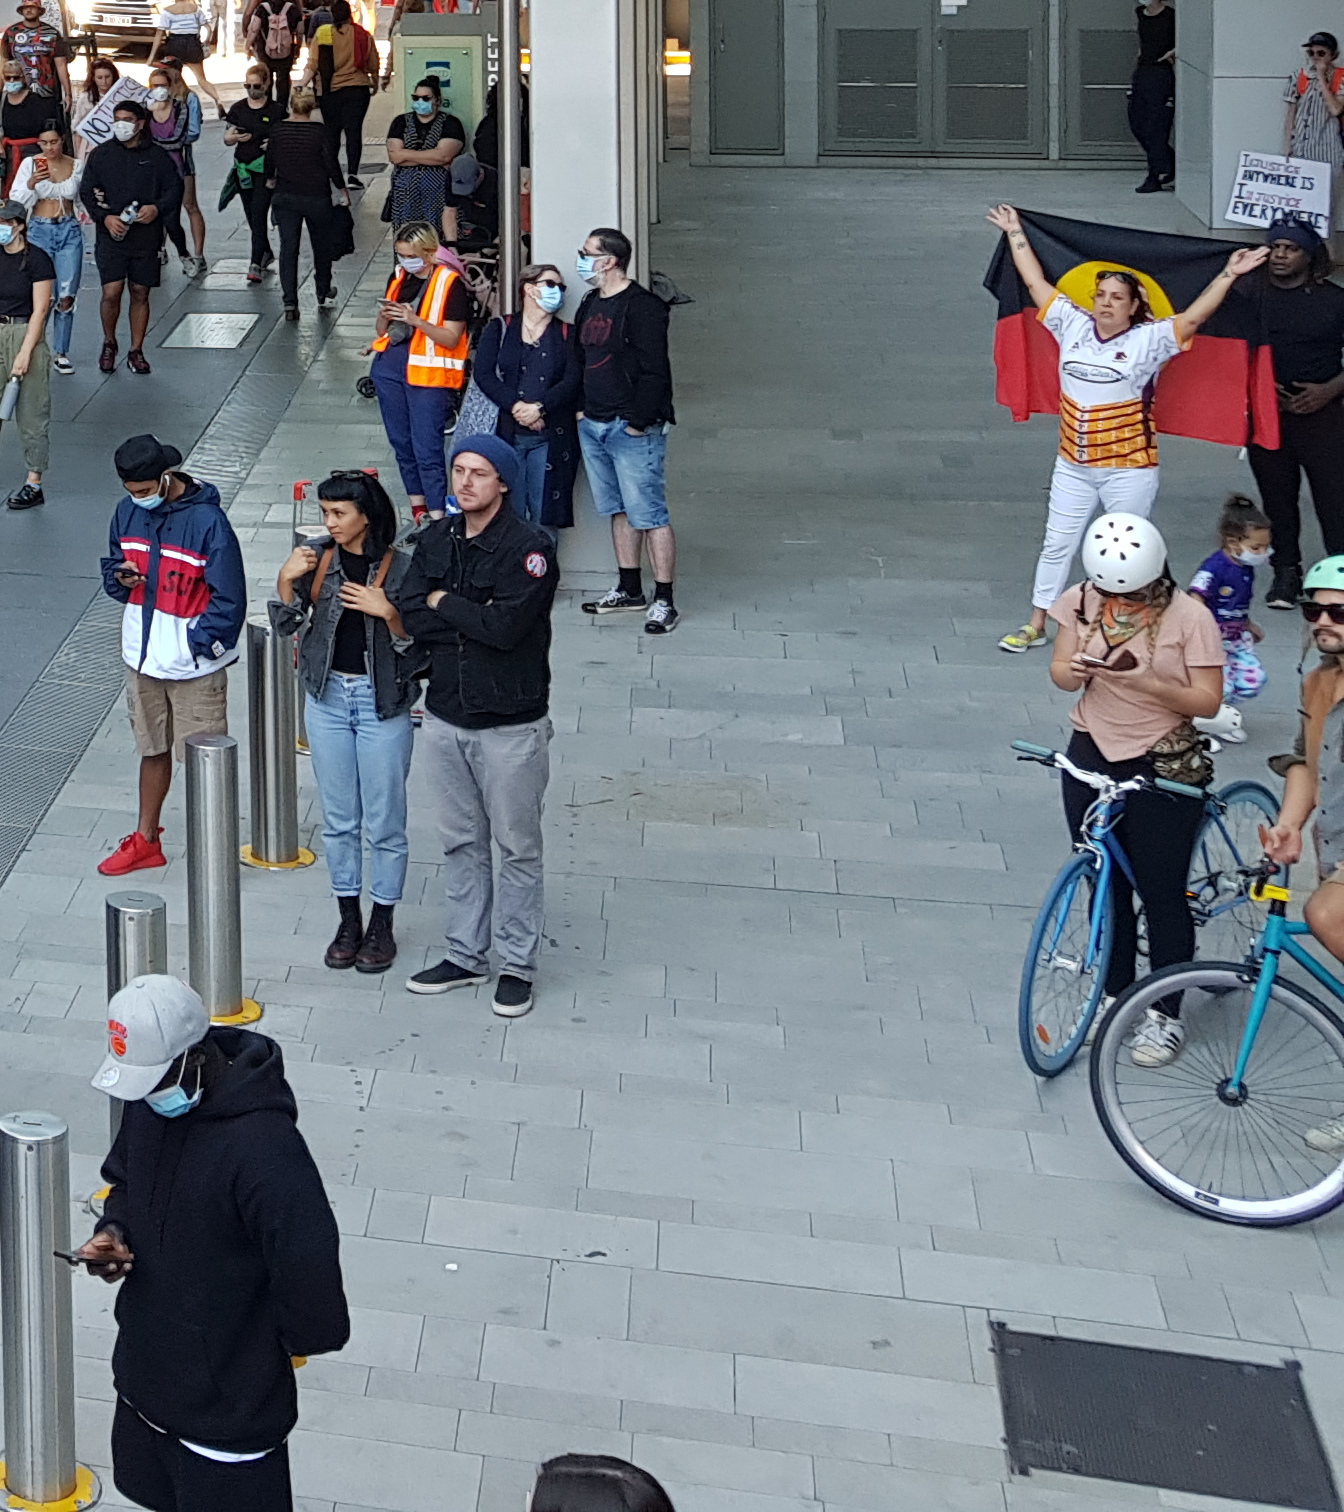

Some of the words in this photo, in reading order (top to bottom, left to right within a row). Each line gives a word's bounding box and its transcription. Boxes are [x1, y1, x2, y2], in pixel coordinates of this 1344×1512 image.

[486, 33, 499, 90] REET
[82, 118, 111, 145] NO
[1242, 170, 1297, 189] ANYWHERE
[1300, 176, 1315, 191] IS
